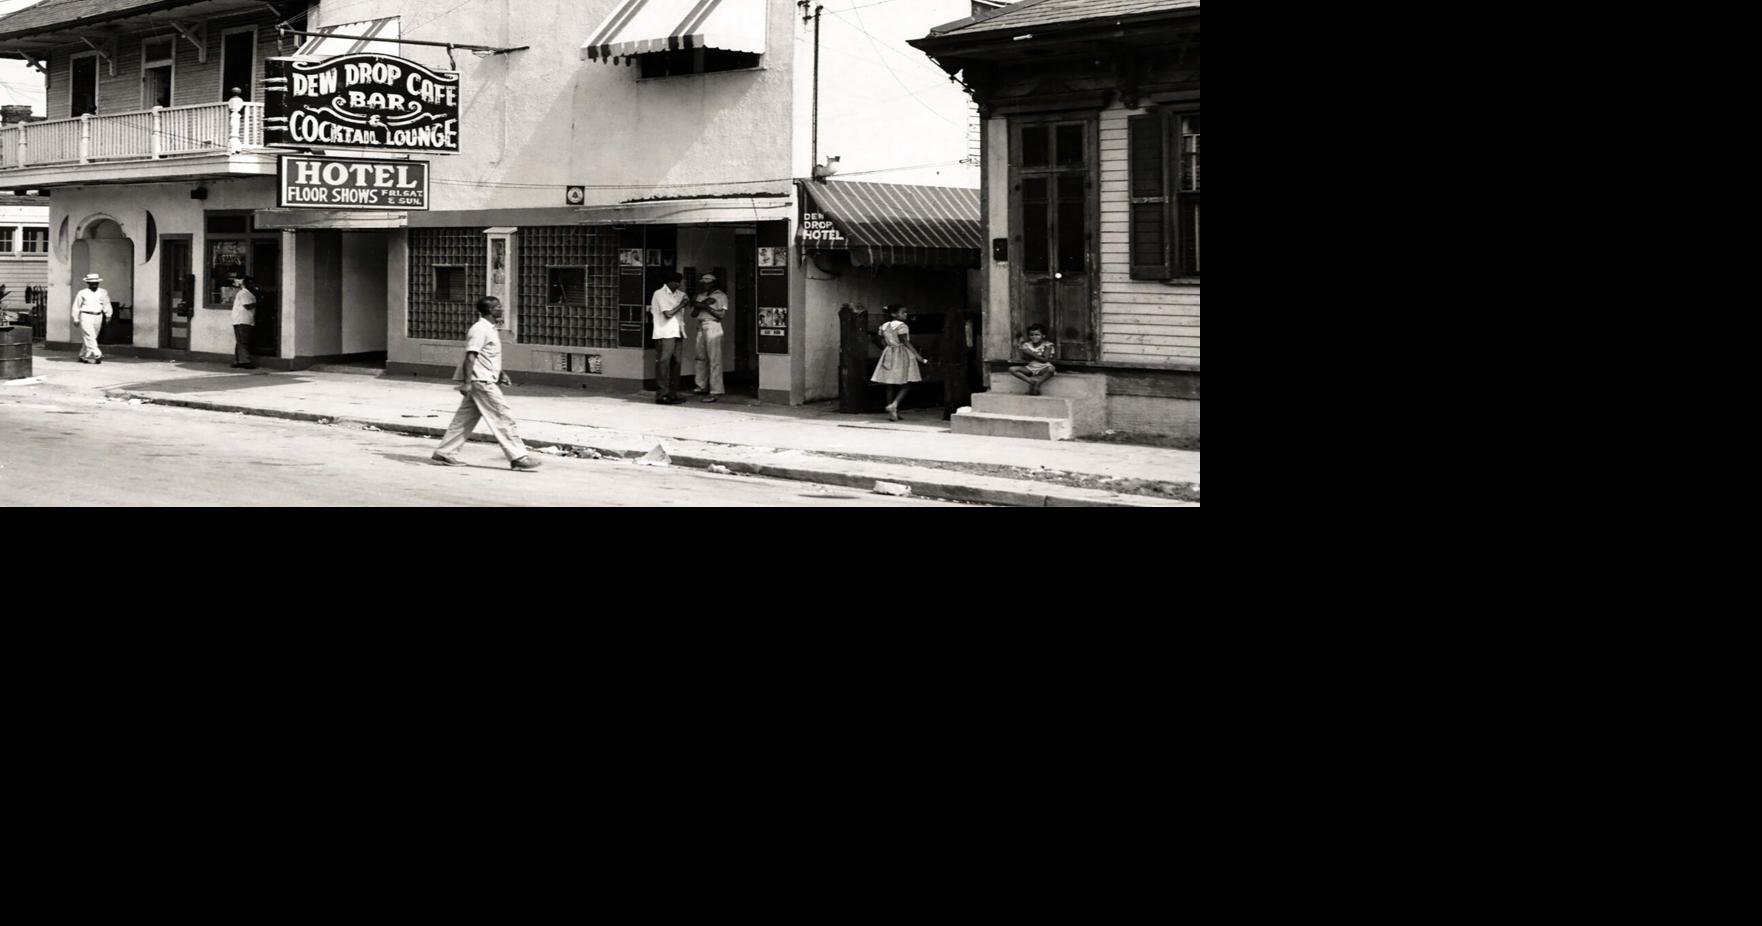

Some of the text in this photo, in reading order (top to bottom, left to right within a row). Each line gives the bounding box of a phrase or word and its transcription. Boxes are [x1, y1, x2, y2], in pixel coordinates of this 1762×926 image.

[292, 62, 457, 107] DEW DROP CAFE
[348, 90, 405, 111] BAR
[289, 110, 457, 148] COCKTAIL LOUNGE
[367, 114, 387, 130] &
[295, 161, 418, 188] HOTEL
[288, 186, 378, 203] FLOOR SHOWS
[804, 221, 833, 229] DROP
[803, 230, 844, 240] HOTEL
